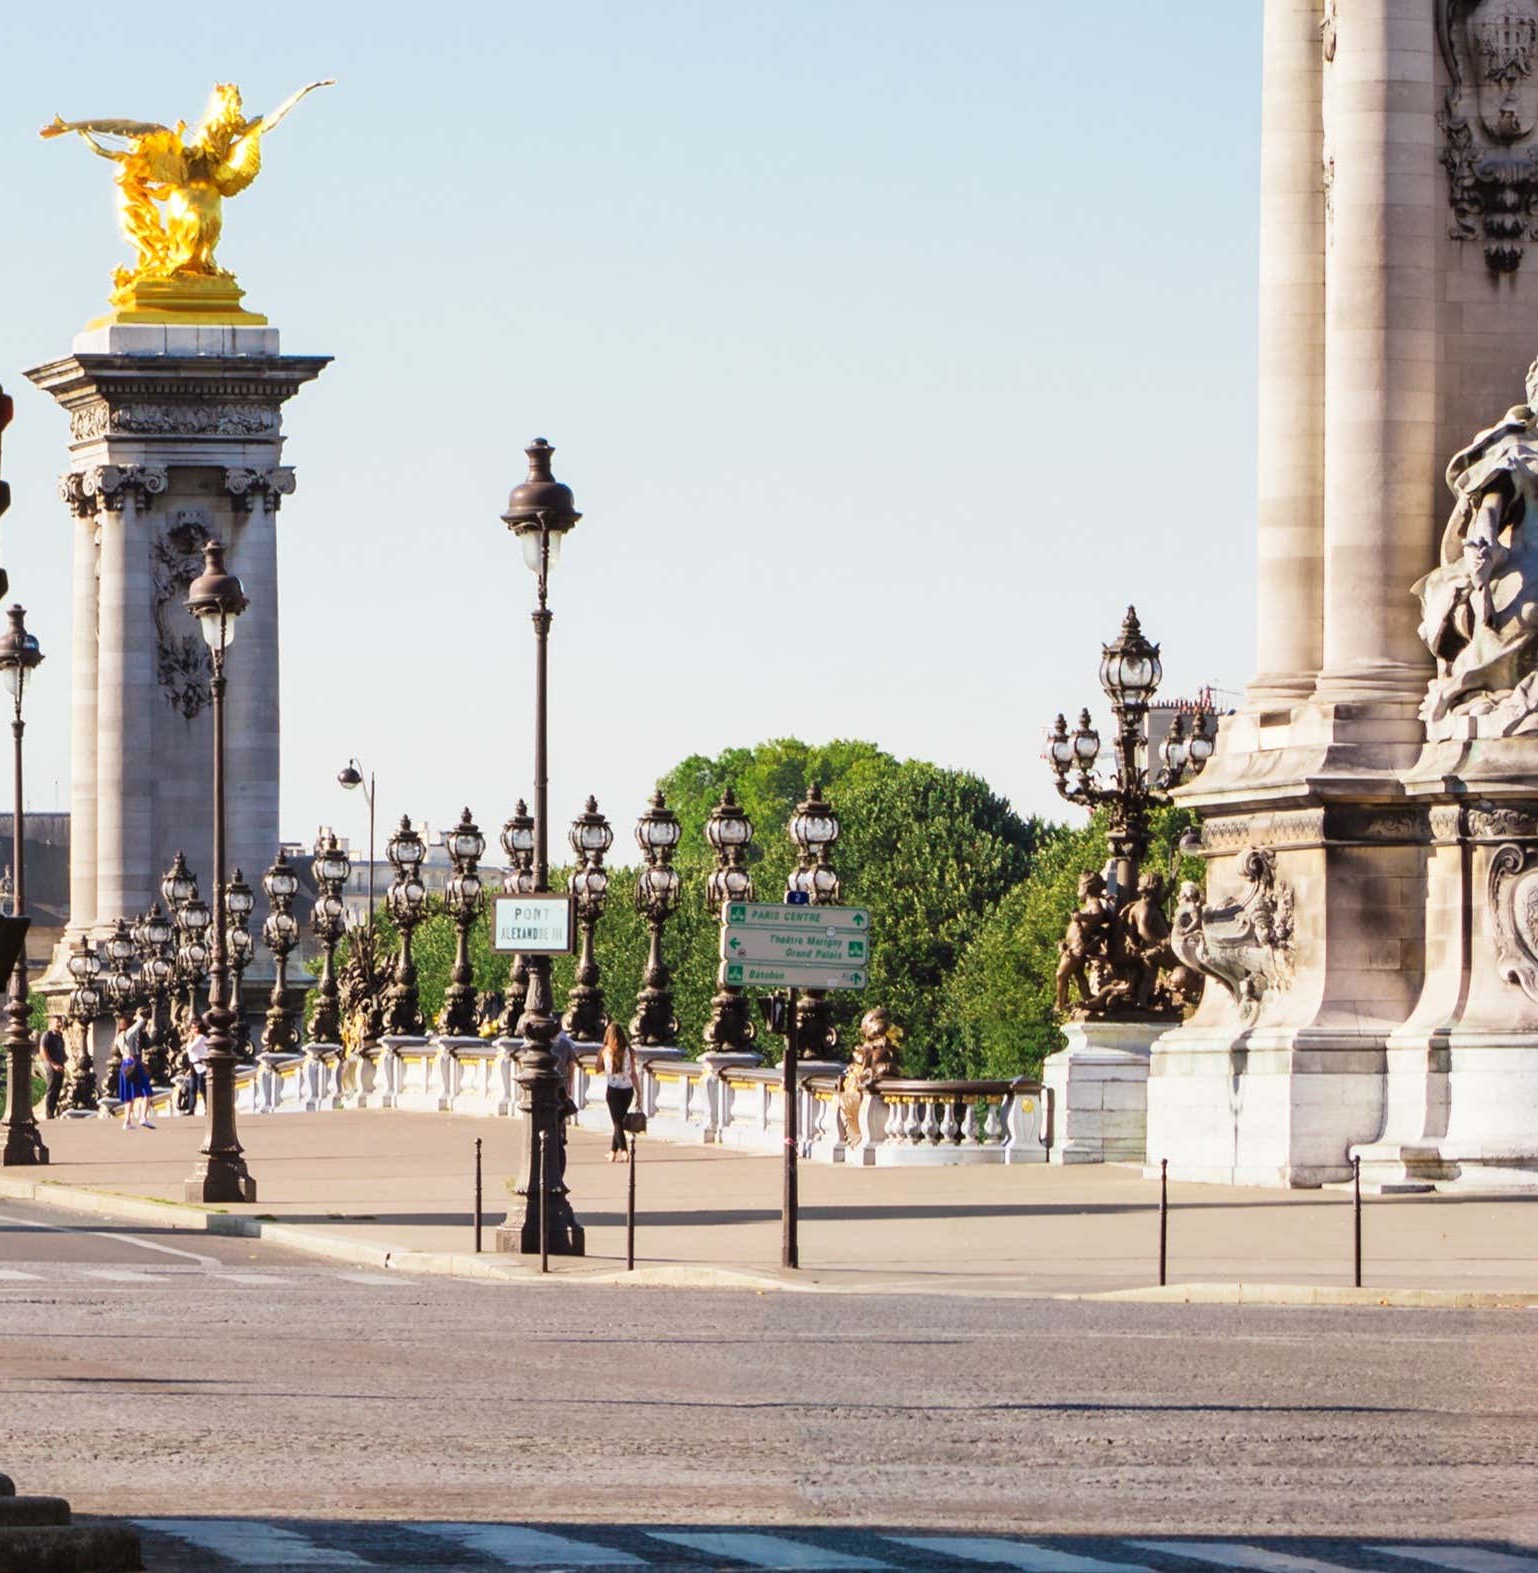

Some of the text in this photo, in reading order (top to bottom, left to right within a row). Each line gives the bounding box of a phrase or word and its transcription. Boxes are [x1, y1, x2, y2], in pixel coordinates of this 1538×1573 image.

[794, 893, 802, 903] 2
[515, 907, 549, 920] PONT
[751, 910, 821, 923] PARIS CENTRE
[501, 927, 563, 940] ALEXANDRE III
[807, 935, 843, 949] Marigny
[785, 948, 843, 960] Grand Palais
